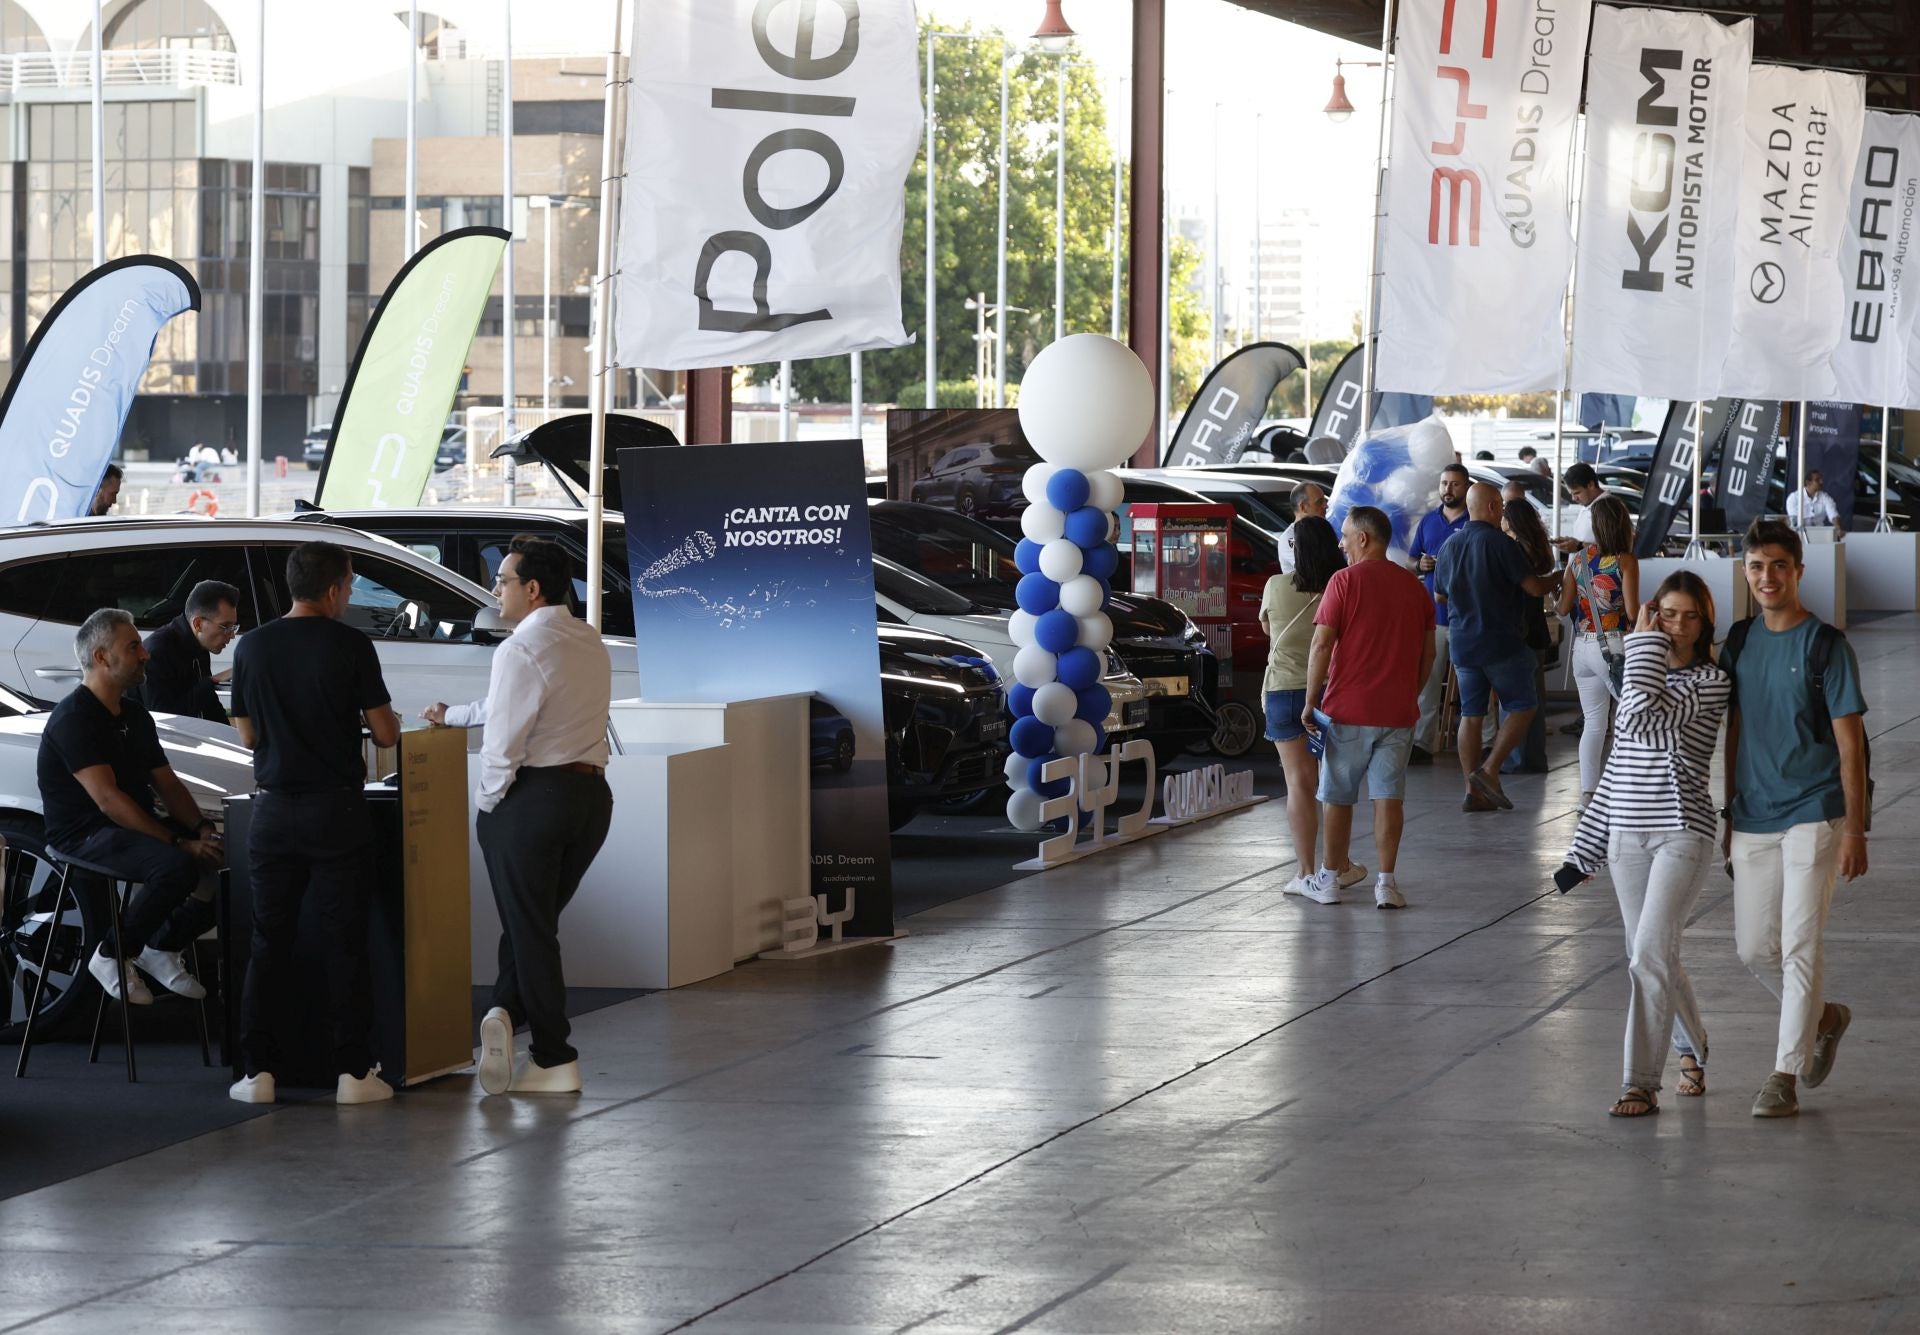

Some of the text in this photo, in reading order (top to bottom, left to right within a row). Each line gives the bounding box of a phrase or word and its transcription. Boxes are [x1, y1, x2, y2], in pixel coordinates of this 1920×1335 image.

[1505, 105, 1543, 248] QUADIS
[1622, 48, 1683, 292] KGM
[1675, 58, 1712, 289] AUTOPISTA MOTOR
[1760, 102, 1796, 245] MAZDA
[1788, 105, 1828, 248] Almenar
[1850, 145, 1899, 343] EBRO
[1889, 177, 1918, 318] Marcos Automoción
[49, 298, 140, 459] QUADIS Dream
[396, 271, 457, 415] QUADIS Dream
[1659, 401, 1713, 506] EBR
[1727, 402, 1764, 496] EBR
[1809, 424, 1838, 435] inspires
[1811, 411, 1827, 420] that
[724, 505, 850, 529] ¡CANTA CON
[1756, 453, 1772, 485] Marcos
[724, 528, 841, 547] NOSOTROS!
[1163, 765, 1215, 820] QUADIS
[822, 873, 875, 882] quadisdream.es
[838, 854, 875, 865] Dream
